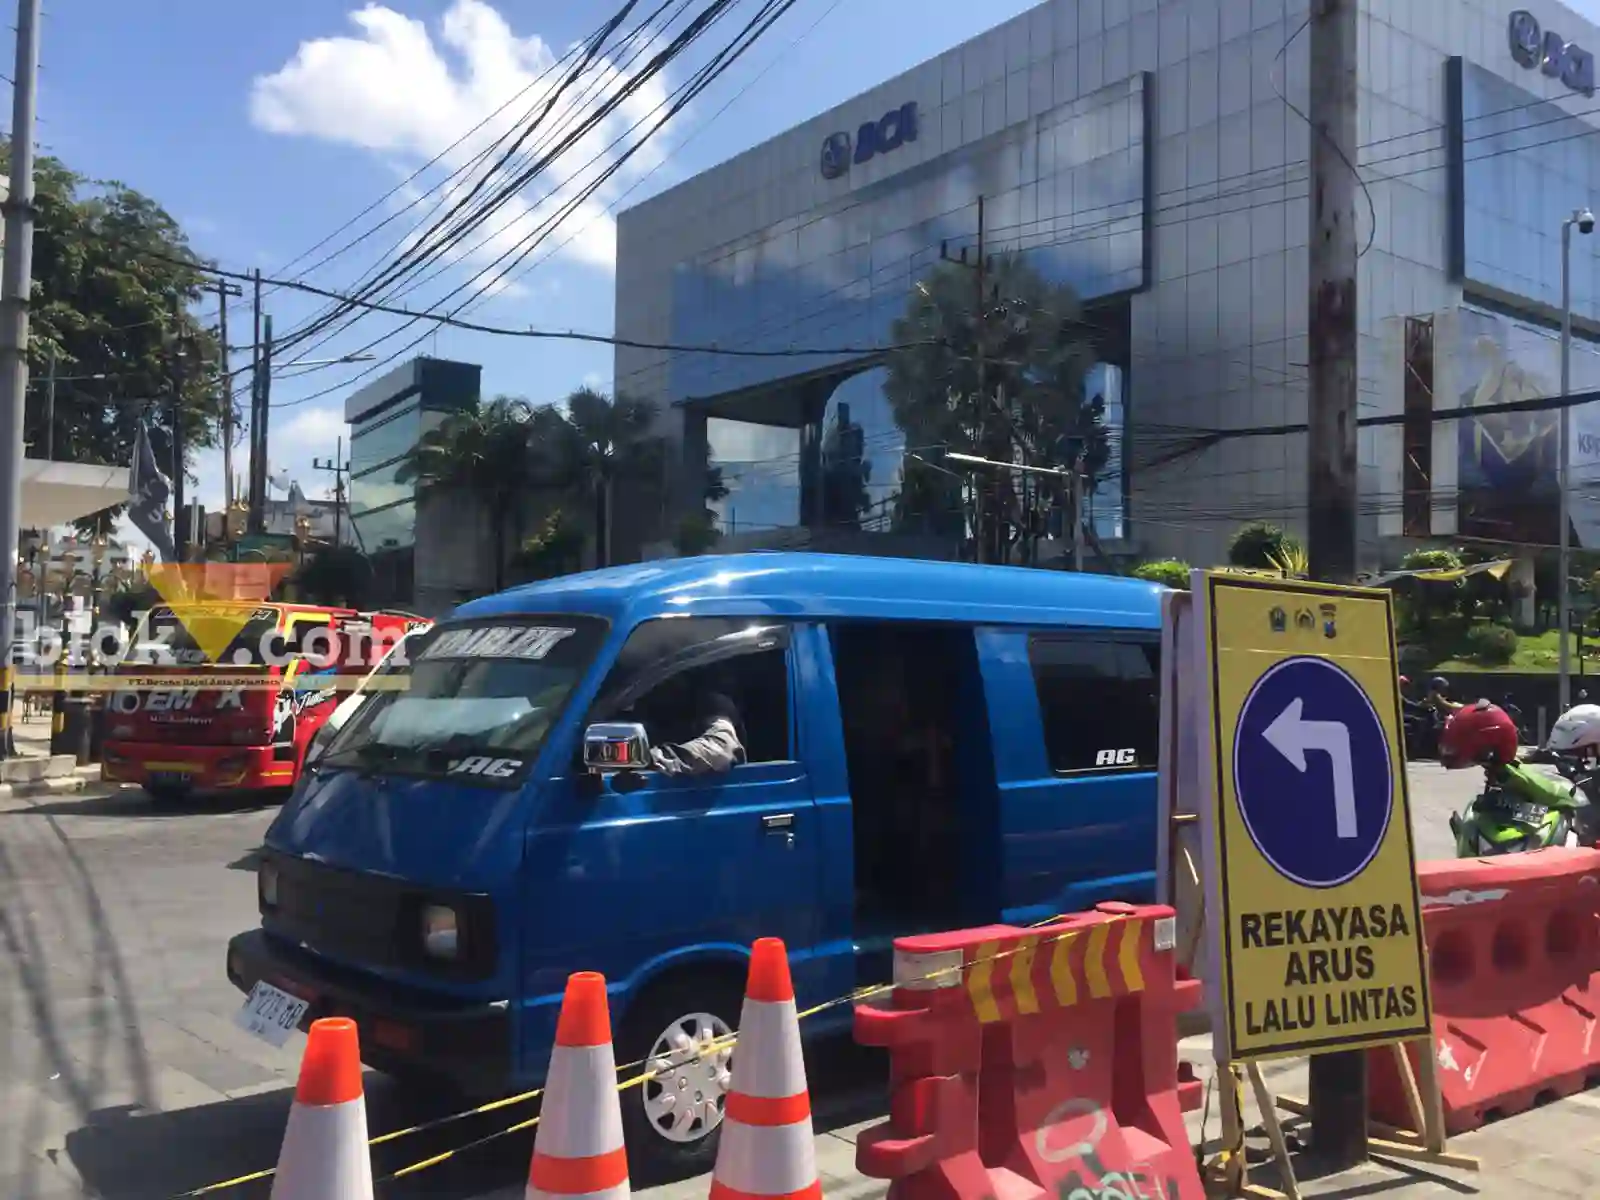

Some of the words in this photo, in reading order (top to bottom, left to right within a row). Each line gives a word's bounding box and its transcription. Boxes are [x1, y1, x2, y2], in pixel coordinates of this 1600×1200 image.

[1096, 748, 1136, 765] AG
[1241, 903, 1410, 949] REKAYASA
[1284, 945, 1375, 987] ARUS
[1245, 995, 1316, 1036] LALU
[1325, 985, 1418, 1026] LINTAS
